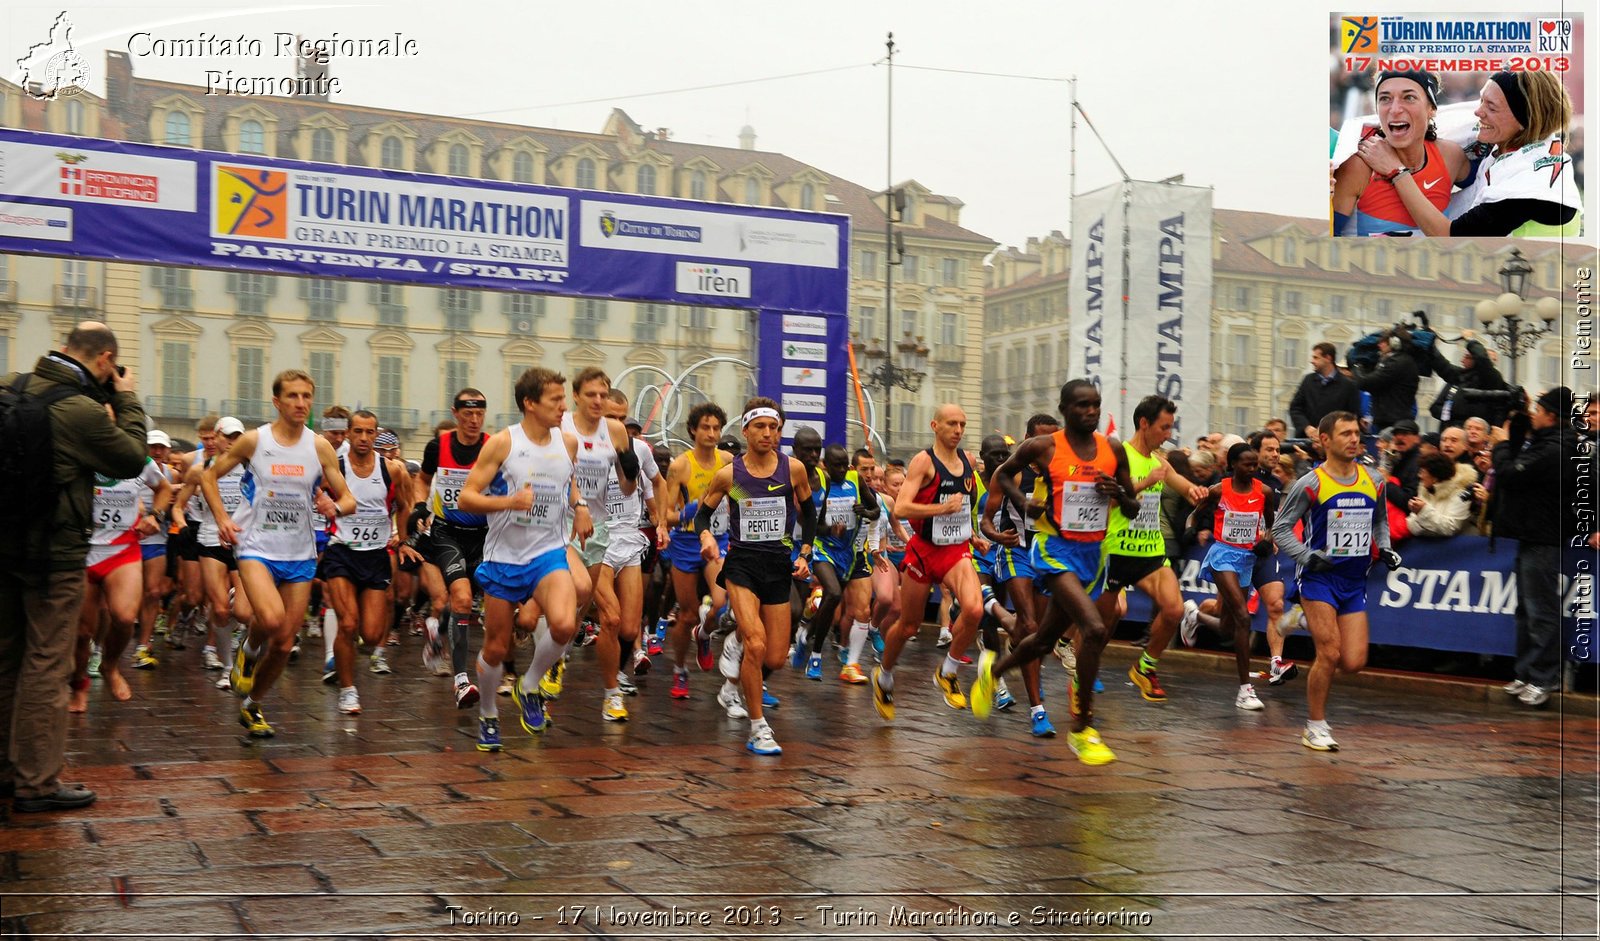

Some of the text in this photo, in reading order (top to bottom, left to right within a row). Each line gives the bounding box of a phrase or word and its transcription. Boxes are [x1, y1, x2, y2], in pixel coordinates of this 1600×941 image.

[87, 172, 156, 187] PROVINCIA
[87, 185, 156, 201] DI TORINO
[295, 183, 563, 240] TURIN MARATHON
[295, 227, 564, 263] GRAN PREMIO LA STAMPA
[210, 242, 568, 283] PARTENZA / START
[698, 272, 739, 294] iren
[1156, 211, 1185, 401] STAMPA
[99, 509, 122, 522] 56
[1078, 507, 1100, 521] PACE
[747, 519, 779, 532] PERTILE
[942, 525, 962, 537] GOFFI
[1228, 527, 1252, 538] JEPTOO
[352, 527, 379, 541] 966
[1332, 532, 1369, 547] 1212
